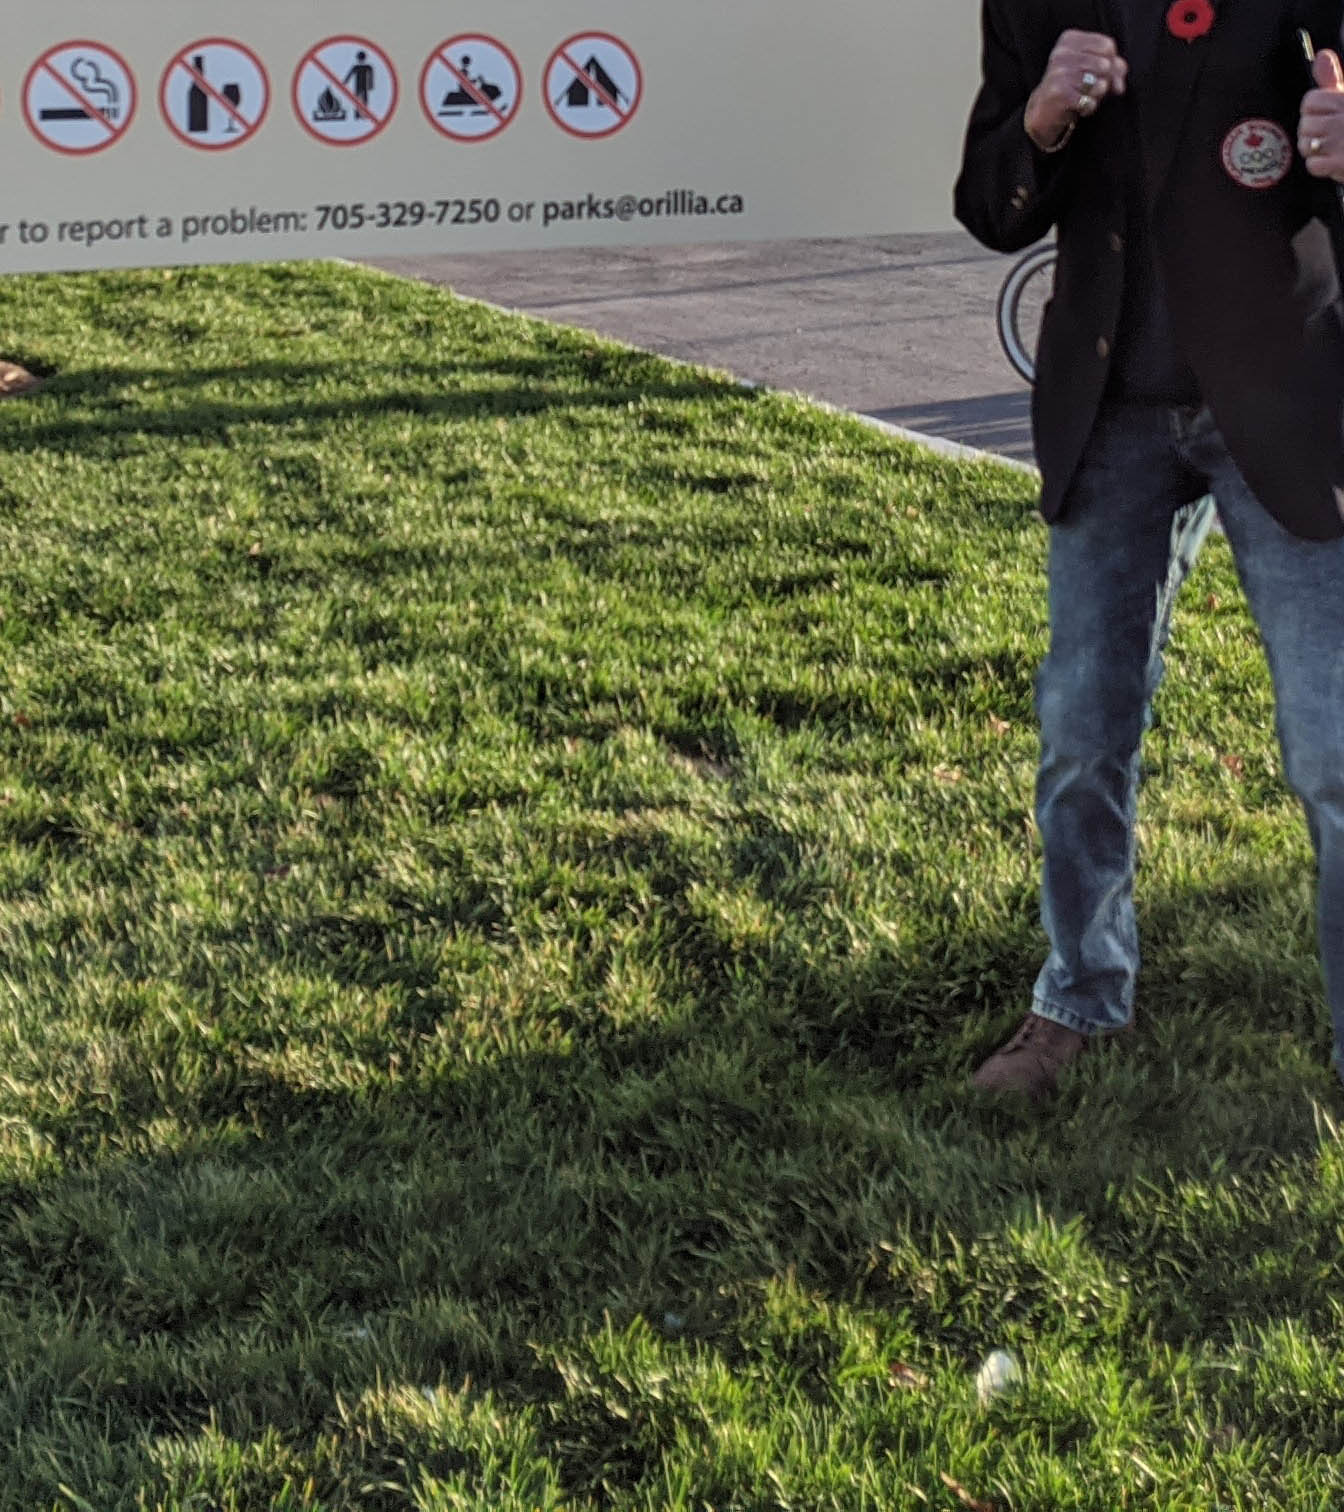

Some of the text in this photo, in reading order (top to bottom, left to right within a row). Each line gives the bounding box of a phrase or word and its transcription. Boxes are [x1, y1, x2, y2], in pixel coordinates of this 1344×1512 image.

[18, 219, 49, 244] to
[58, 214, 148, 247] report
[155, 216, 172, 238] a
[181, 207, 308, 243] problem:
[314, 198, 501, 231] 705-329-7250
[507, 201, 534, 223] or
[542, 189, 744, 226] parks@orillia.ca
